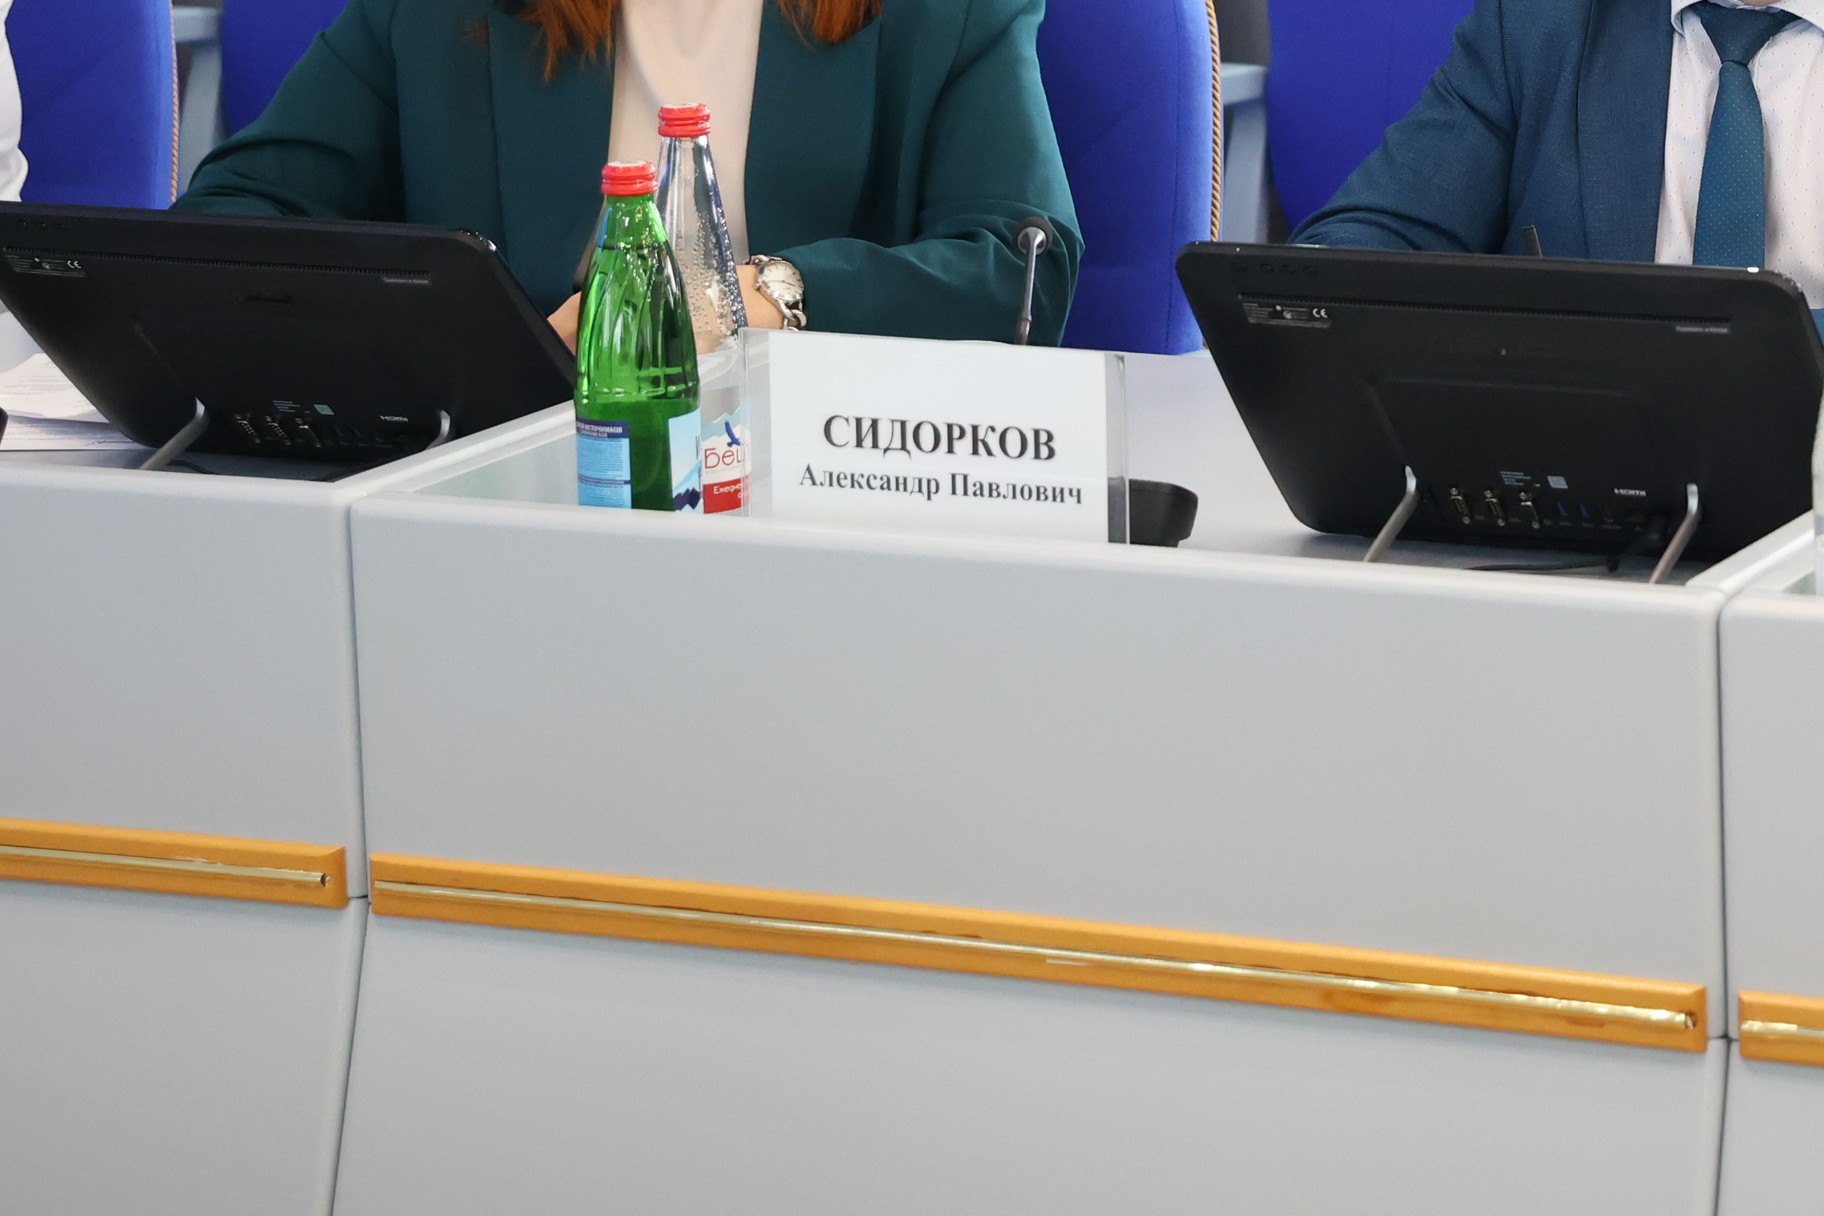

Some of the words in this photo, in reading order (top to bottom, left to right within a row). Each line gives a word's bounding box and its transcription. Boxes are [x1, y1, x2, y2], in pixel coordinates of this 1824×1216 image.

[823, 414, 1056, 461] СИДОРКОВ
[800, 463, 940, 501] Александр
[949, 472, 1083, 505] Павлович
